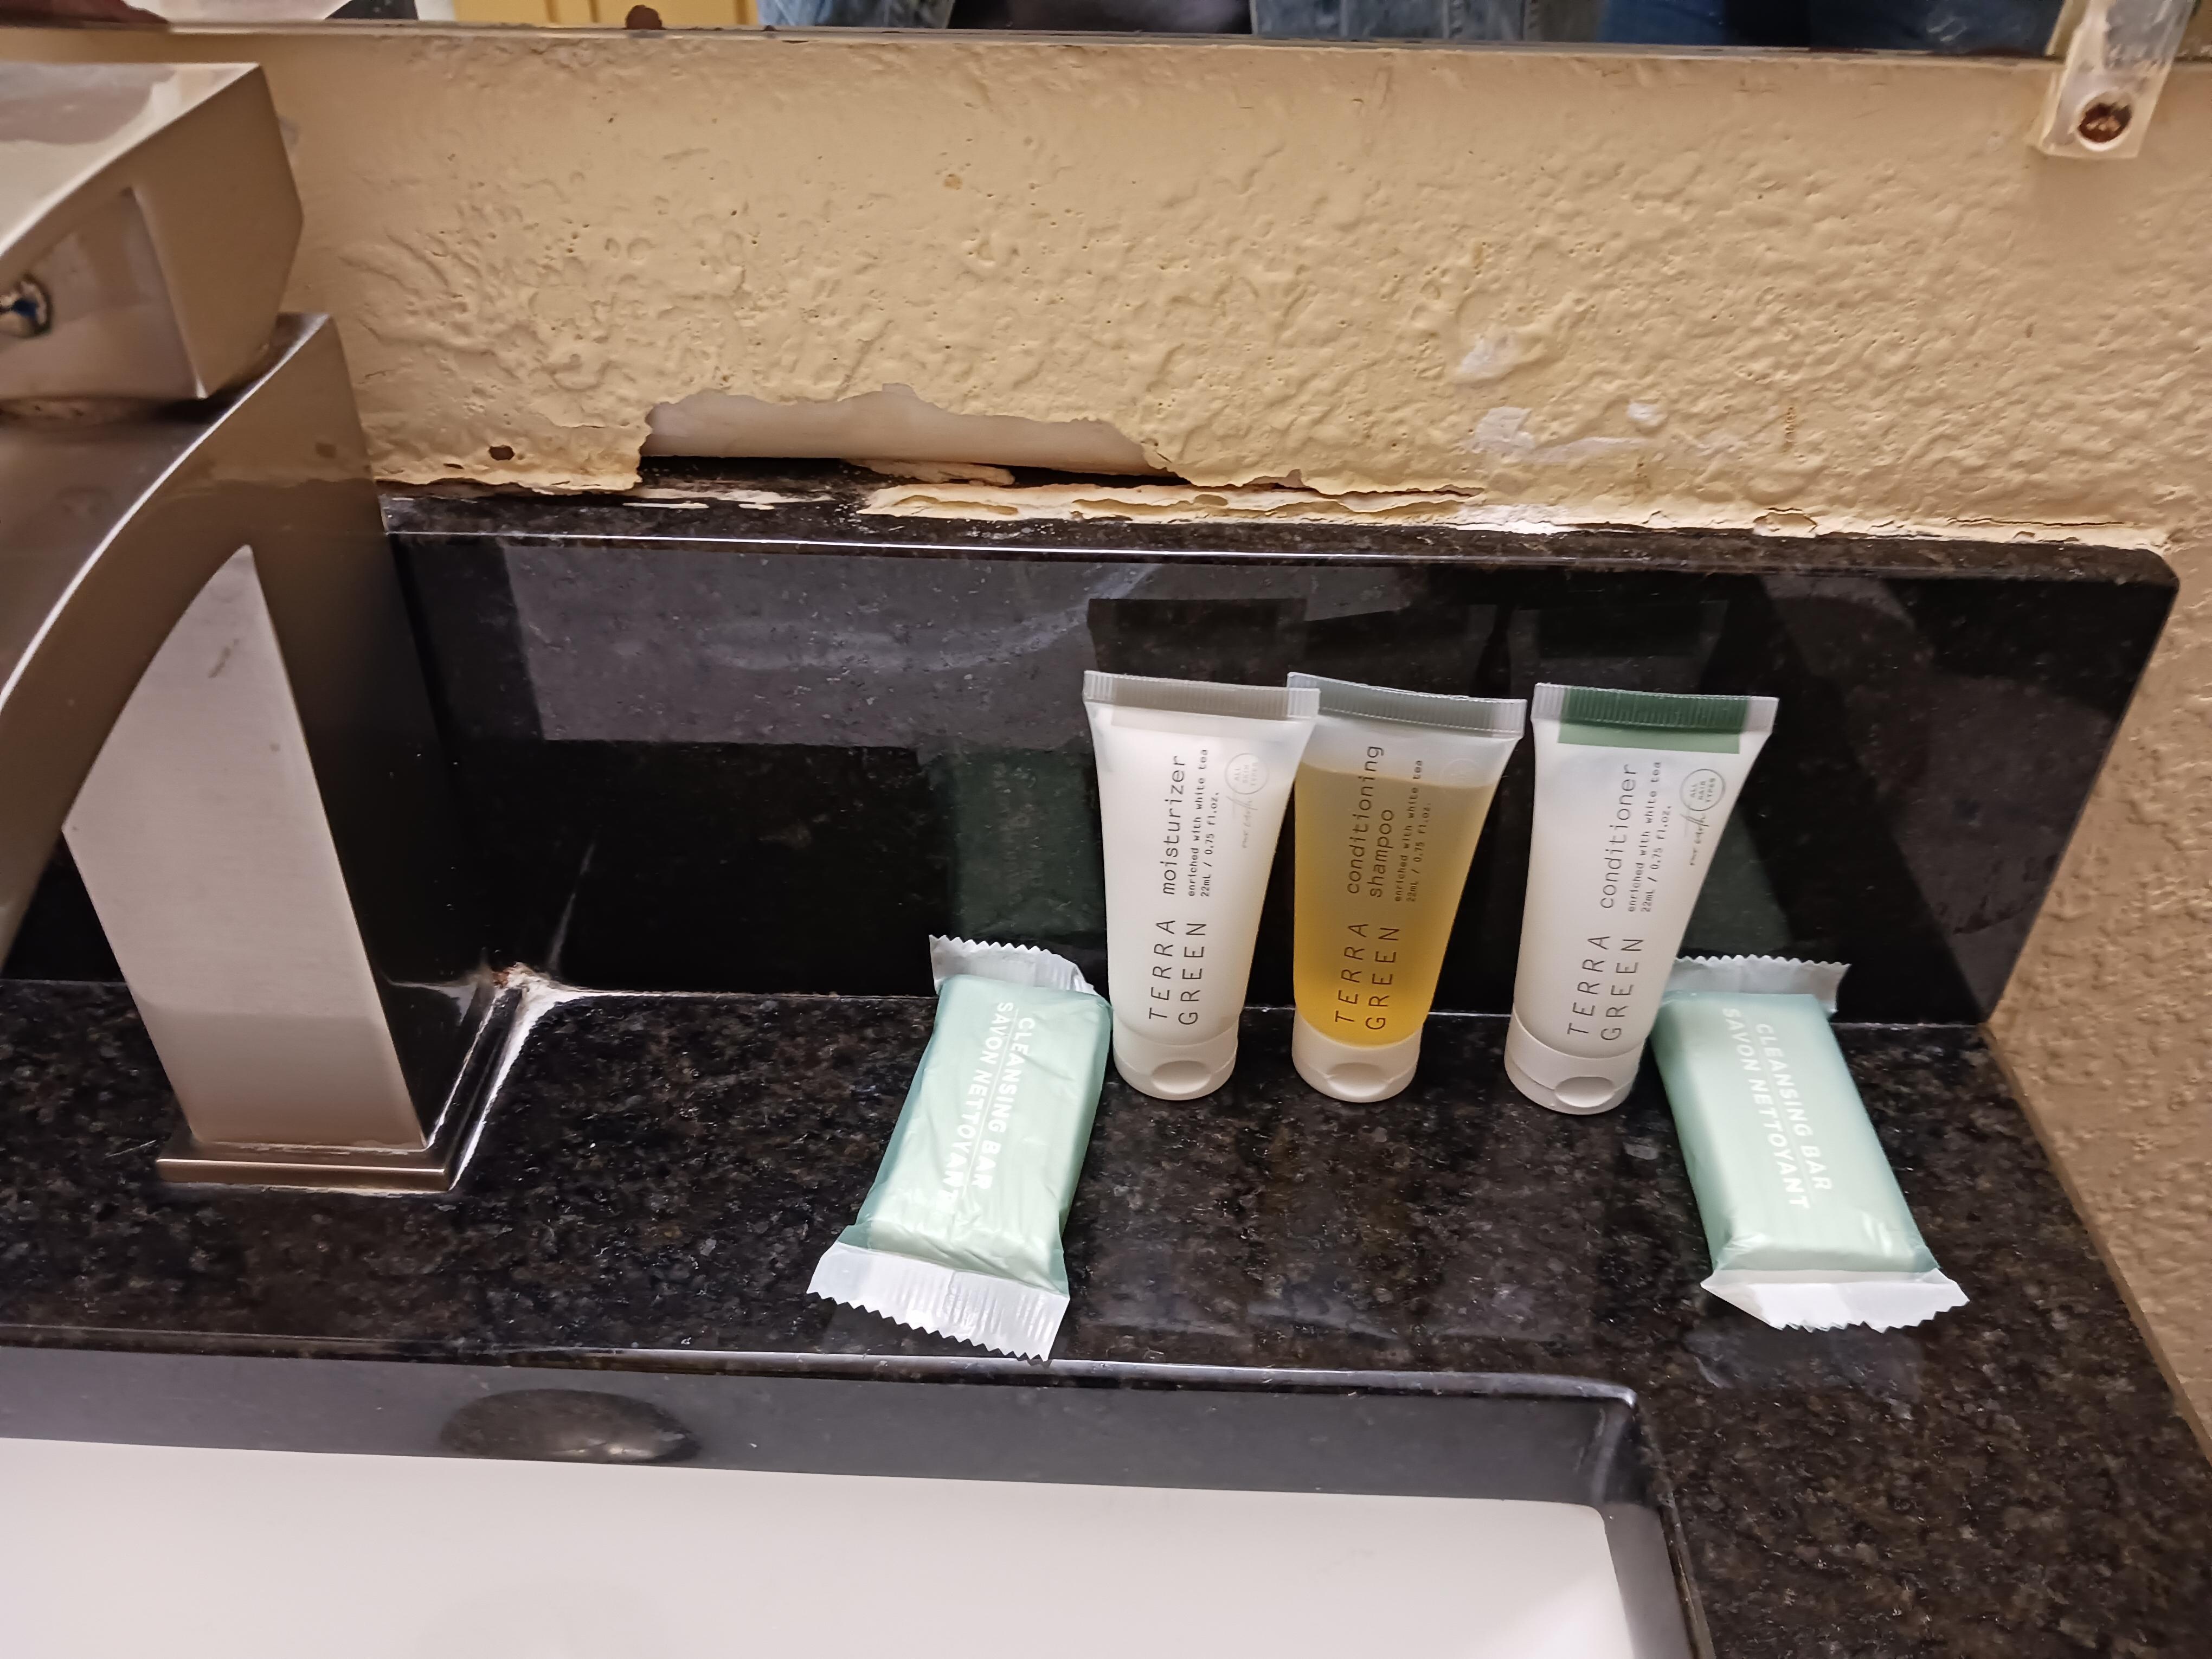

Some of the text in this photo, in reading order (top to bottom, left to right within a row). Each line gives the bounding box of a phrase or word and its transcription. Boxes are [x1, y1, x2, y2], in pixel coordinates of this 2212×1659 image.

[1160, 756, 1186, 895] moisturizer
[1187, 749, 1208, 897] enriched with white tea
[1347, 746, 1385, 894] conditioning
[1394, 760, 1423, 902] enriched with white tea
[1600, 764, 1638, 909] conditioner
[1628, 762, 1662, 912] enriched with white tea
[1689, 783, 1698, 798] ALL
[1200, 874, 1211, 897] 22mL
[1204, 833, 1215, 855] 0.75
[1367, 809, 1395, 898] shampoo
[1406, 882, 1419, 902] 22mL
[1413, 841, 1425, 862] 0.75
[1640, 889, 1655, 912] 22mL
[1649, 847, 1663, 870] 0.75
[1149, 920, 1175, 1019] TERRA
[1178, 923, 1207, 1025] GREEN
[1335, 924, 1369, 1023] TERRA
[1365, 927, 1400, 1030] GREEN
[1567, 936, 1611, 1035] TERRA
[1600, 939, 1645, 1041] GREEN
[979, 1002, 1014, 1065] SAVON
[971, 1017, 1035, 1190] CLEANSING BAR
[1722, 1008, 1811, 1209] SAVON NETTOYANT
[1755, 1023, 1832, 1190] CLEANSING BAR
